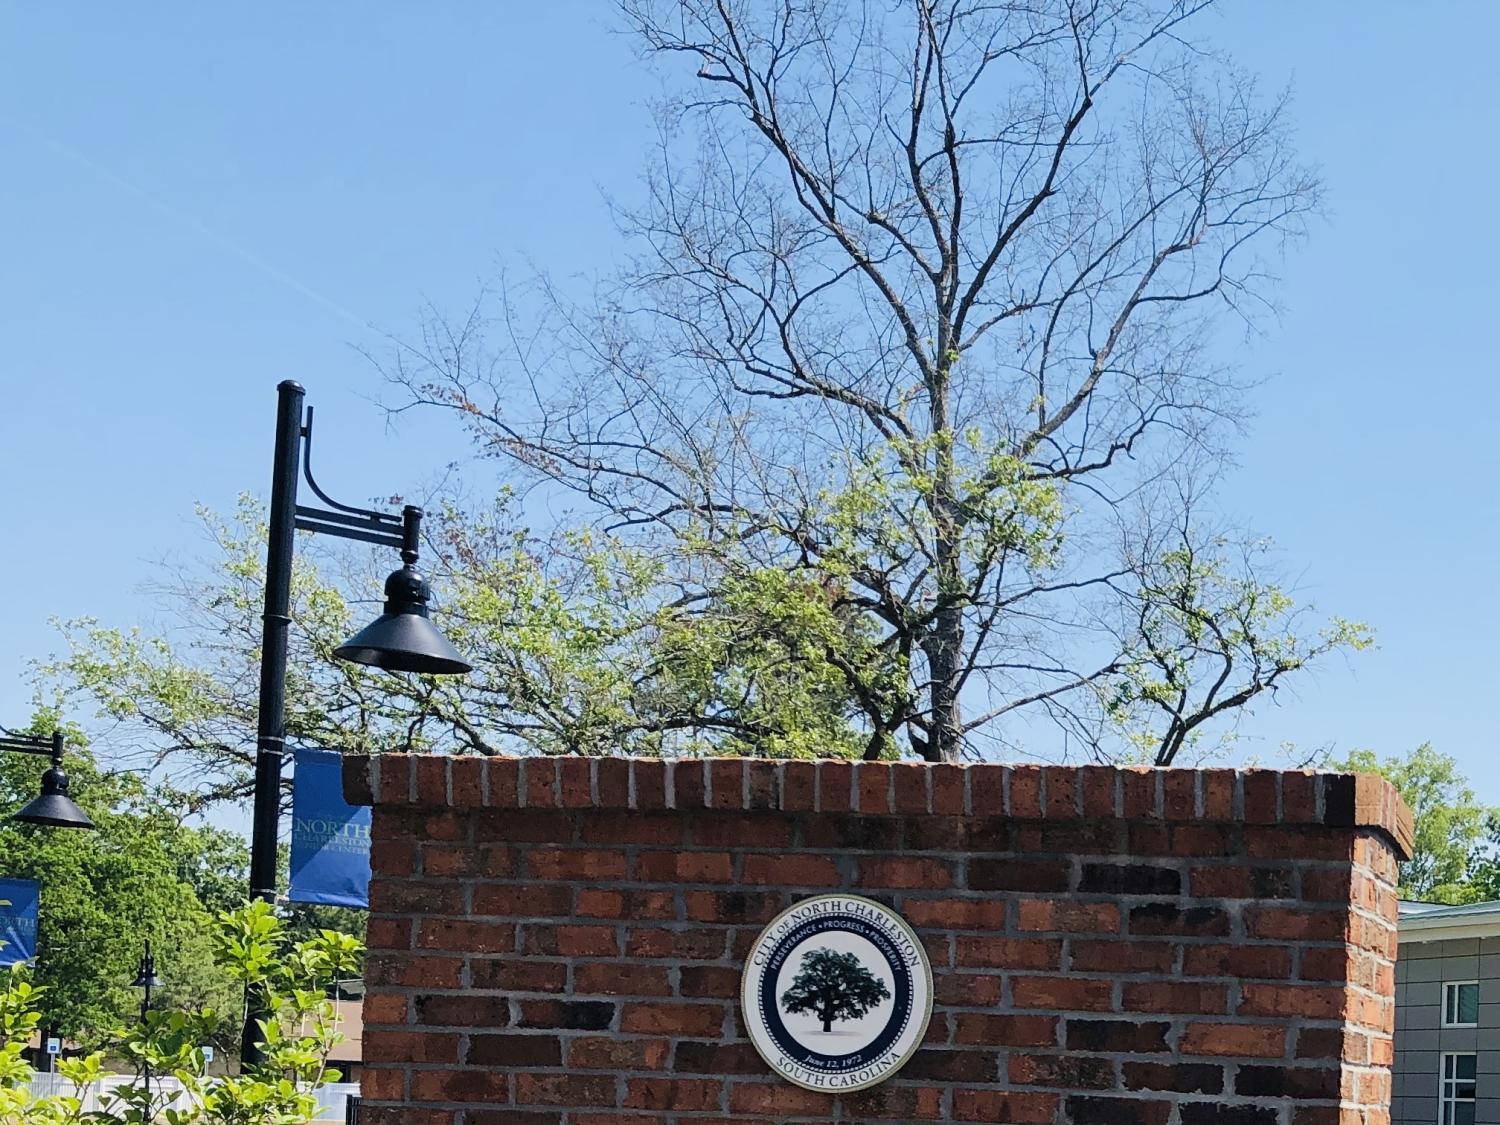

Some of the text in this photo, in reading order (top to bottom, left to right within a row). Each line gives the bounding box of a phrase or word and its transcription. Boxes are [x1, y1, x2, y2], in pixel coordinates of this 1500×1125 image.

[294, 818, 369, 839] NORTH
[754, 901, 920, 967] CITY OF NORTH CHARLESTON
[770, 920, 902, 970] PERSEVERANCE PROGRESS PROSPERITY
[777, 1052, 900, 1087] SOUTH CAROLINA
[804, 1054, 825, 1067] June
[842, 1055, 862, 1067] 1972
